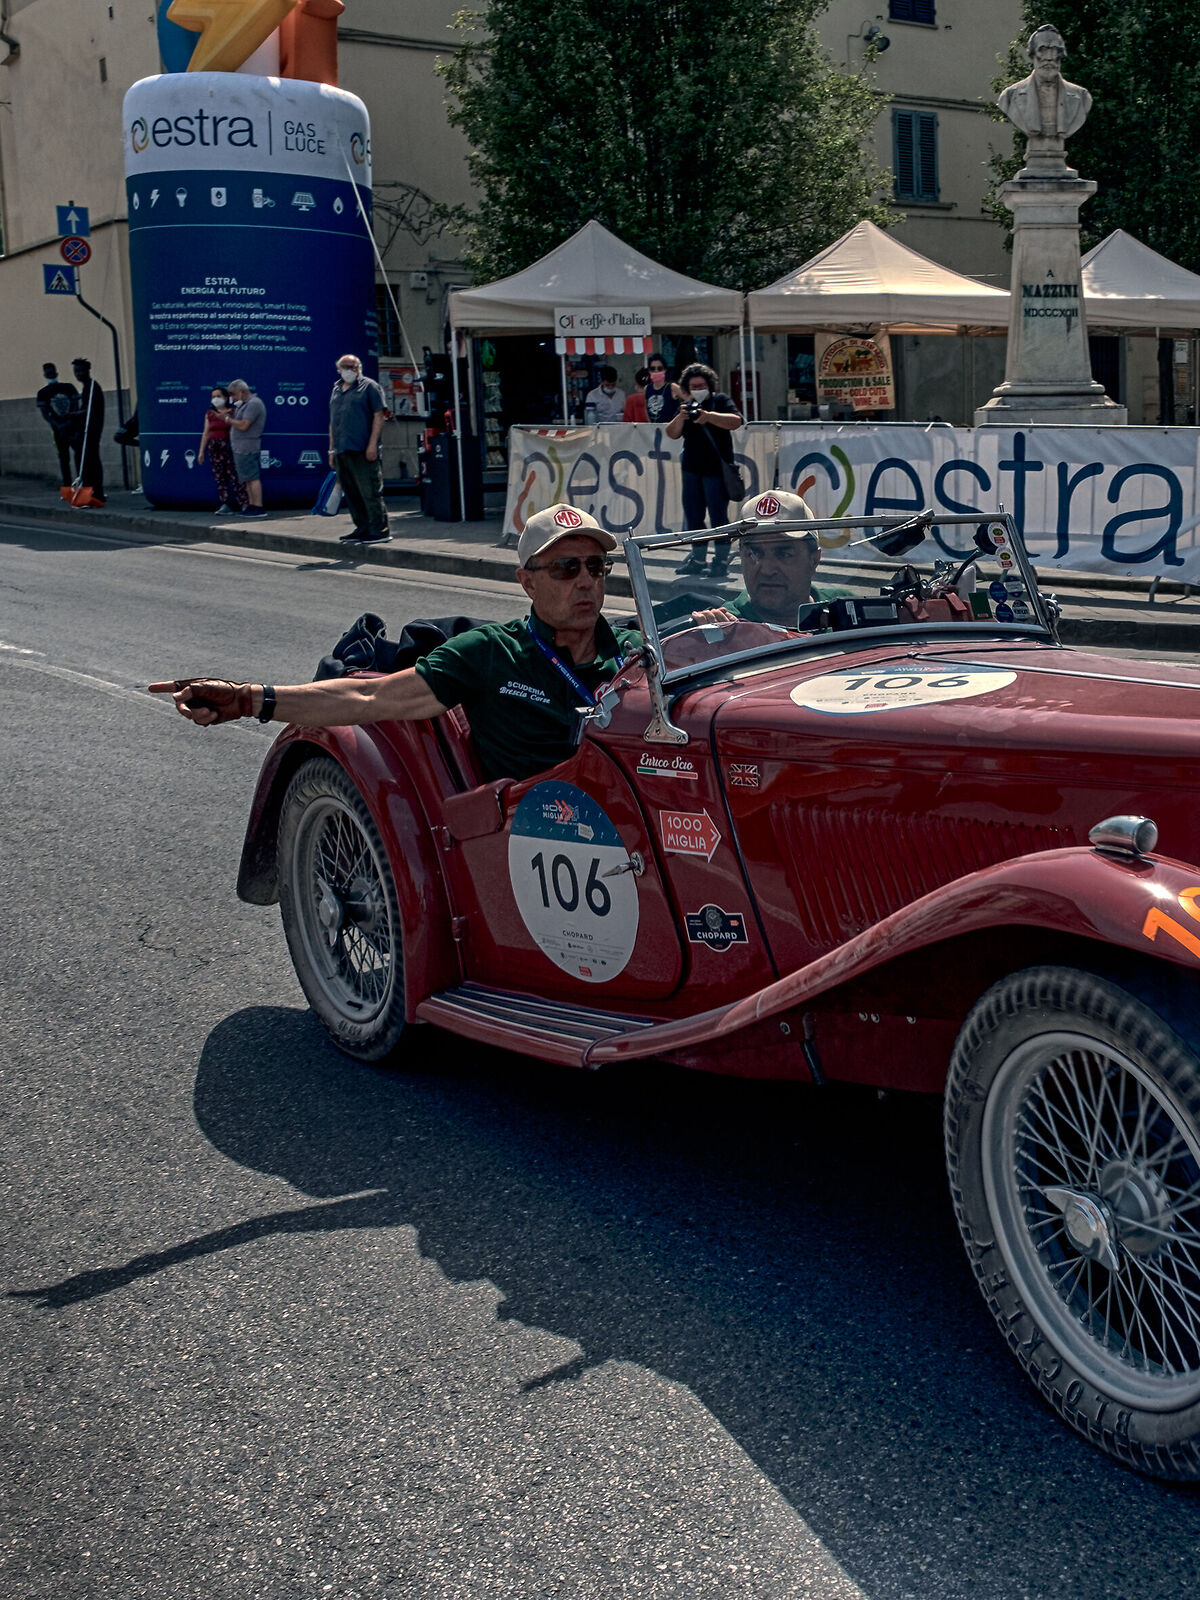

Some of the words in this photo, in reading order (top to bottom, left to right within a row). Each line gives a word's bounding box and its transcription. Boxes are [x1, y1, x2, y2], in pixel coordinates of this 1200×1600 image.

[151, 108, 258, 149] estra
[284, 120, 316, 138] GAS
[284, 138, 326, 155] LUCE
[205, 277, 238, 286] ESTRA
[1046, 269, 1055, 278] A
[181, 287, 215, 295] ENERGIA
[217, 287, 229, 295] AL
[230, 287, 266, 295] FUTURO
[1022, 284, 1078, 298] MAZZINI
[229, 323, 242, 331] per
[579, 312, 606, 329] caffè
[608, 313, 646, 326] d'Italia
[819, 377, 863, 388] PRODUCTION
[872, 375, 891, 386] SALE
[849, 388, 867, 397] COLD
[869, 387, 886, 395] CUTS
[853, 396, 872, 406] WINE
[879, 396, 890, 405] OIL
[756, 497, 780, 515] MG
[864, 431, 1186, 566] estra
[555, 511, 581, 527] MG
[507, 681, 546, 697] SCUDERIA
[843, 674, 971, 692] 106
[499, 686, 528, 698] Brescia
[530, 694, 551, 704] Corse
[640, 753, 669, 768] Enrico
[667, 816, 702, 832] 1000
[667, 833, 706, 850] MIGLIA
[531, 852, 611, 917] 106
[562, 930, 594, 940] CHOPARD
[696, 931, 738, 940] CHOPARD
